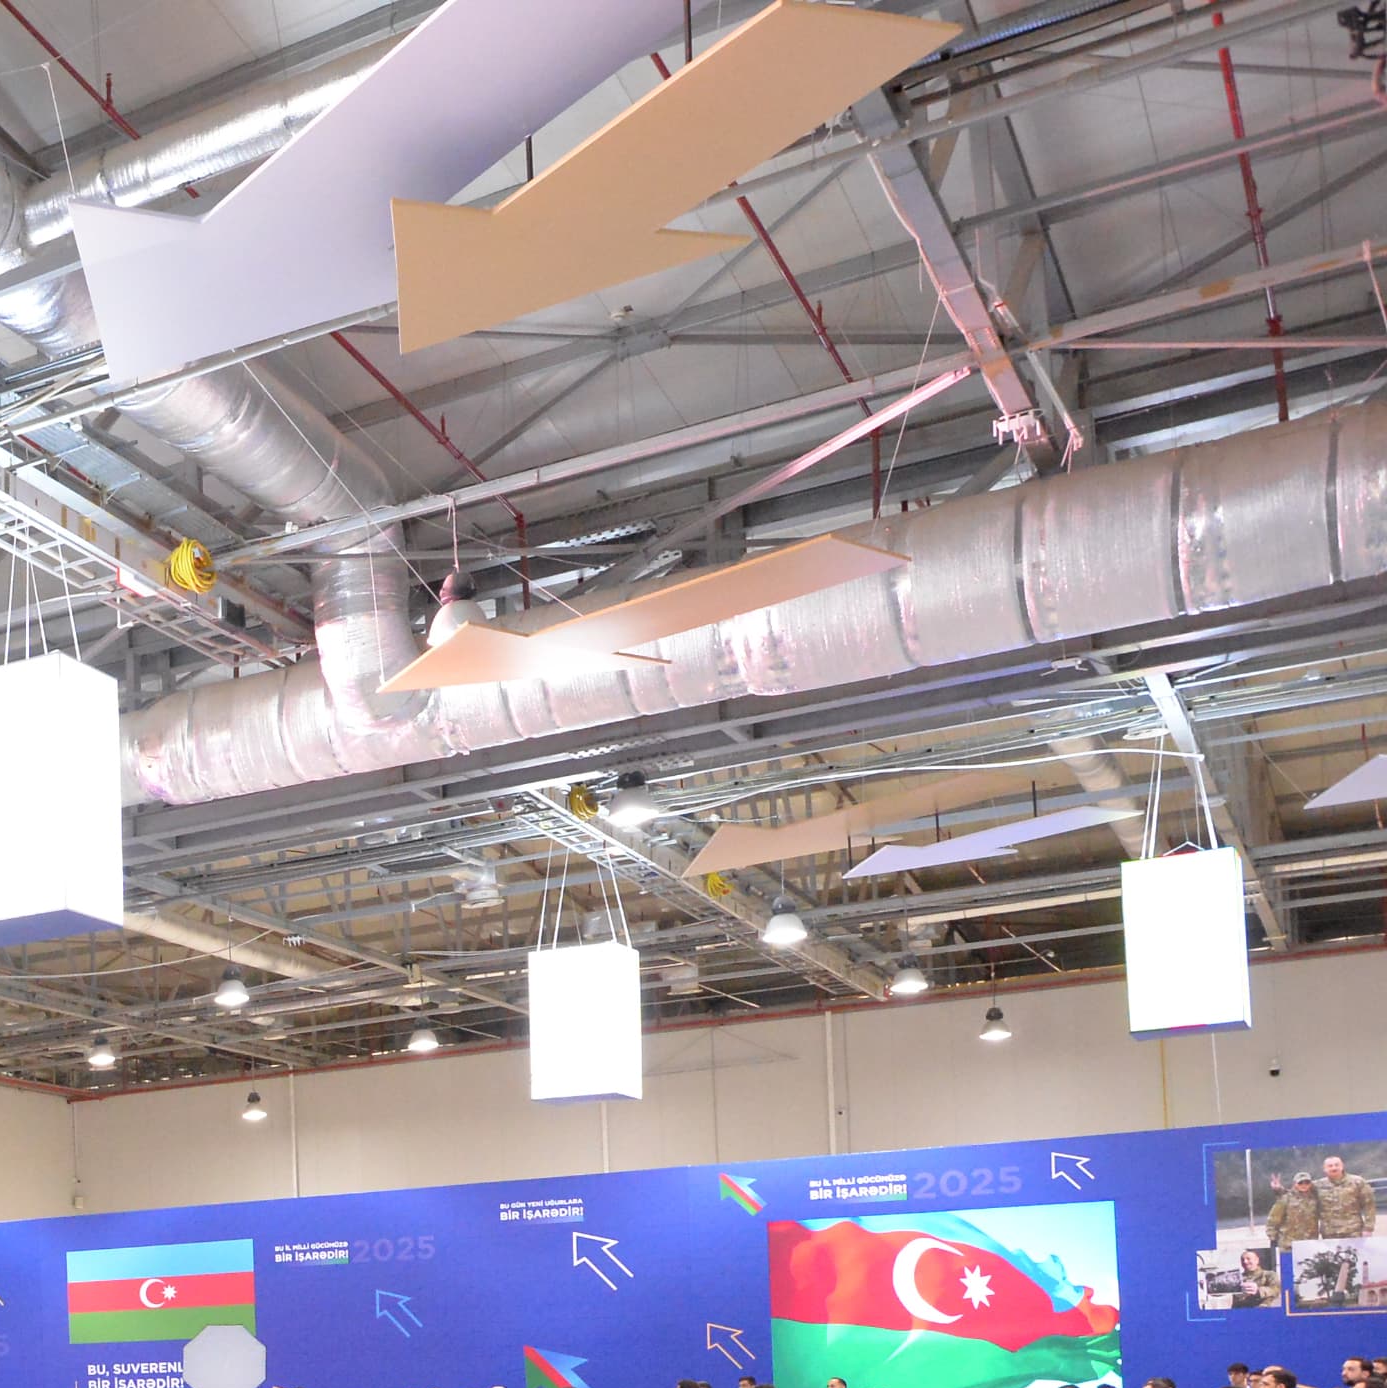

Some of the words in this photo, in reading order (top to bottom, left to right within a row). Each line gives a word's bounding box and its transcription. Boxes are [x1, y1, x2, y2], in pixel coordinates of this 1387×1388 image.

[809, 1187, 833, 1200] BİR
[836, 1182, 907, 1200] İŞARƏDİR!
[912, 1166, 1023, 1199] 2025
[500, 1209, 520, 1221] BİR
[522, 1205, 584, 1220] İŞARƏDİR!
[275, 1251, 293, 1263] BİR
[295, 1248, 349, 1262] İŞARƏDİR!
[352, 1235, 436, 1263] 2025
[87, 1364, 110, 1377] BU,
[113, 1361, 184, 1375] SUVERENL
